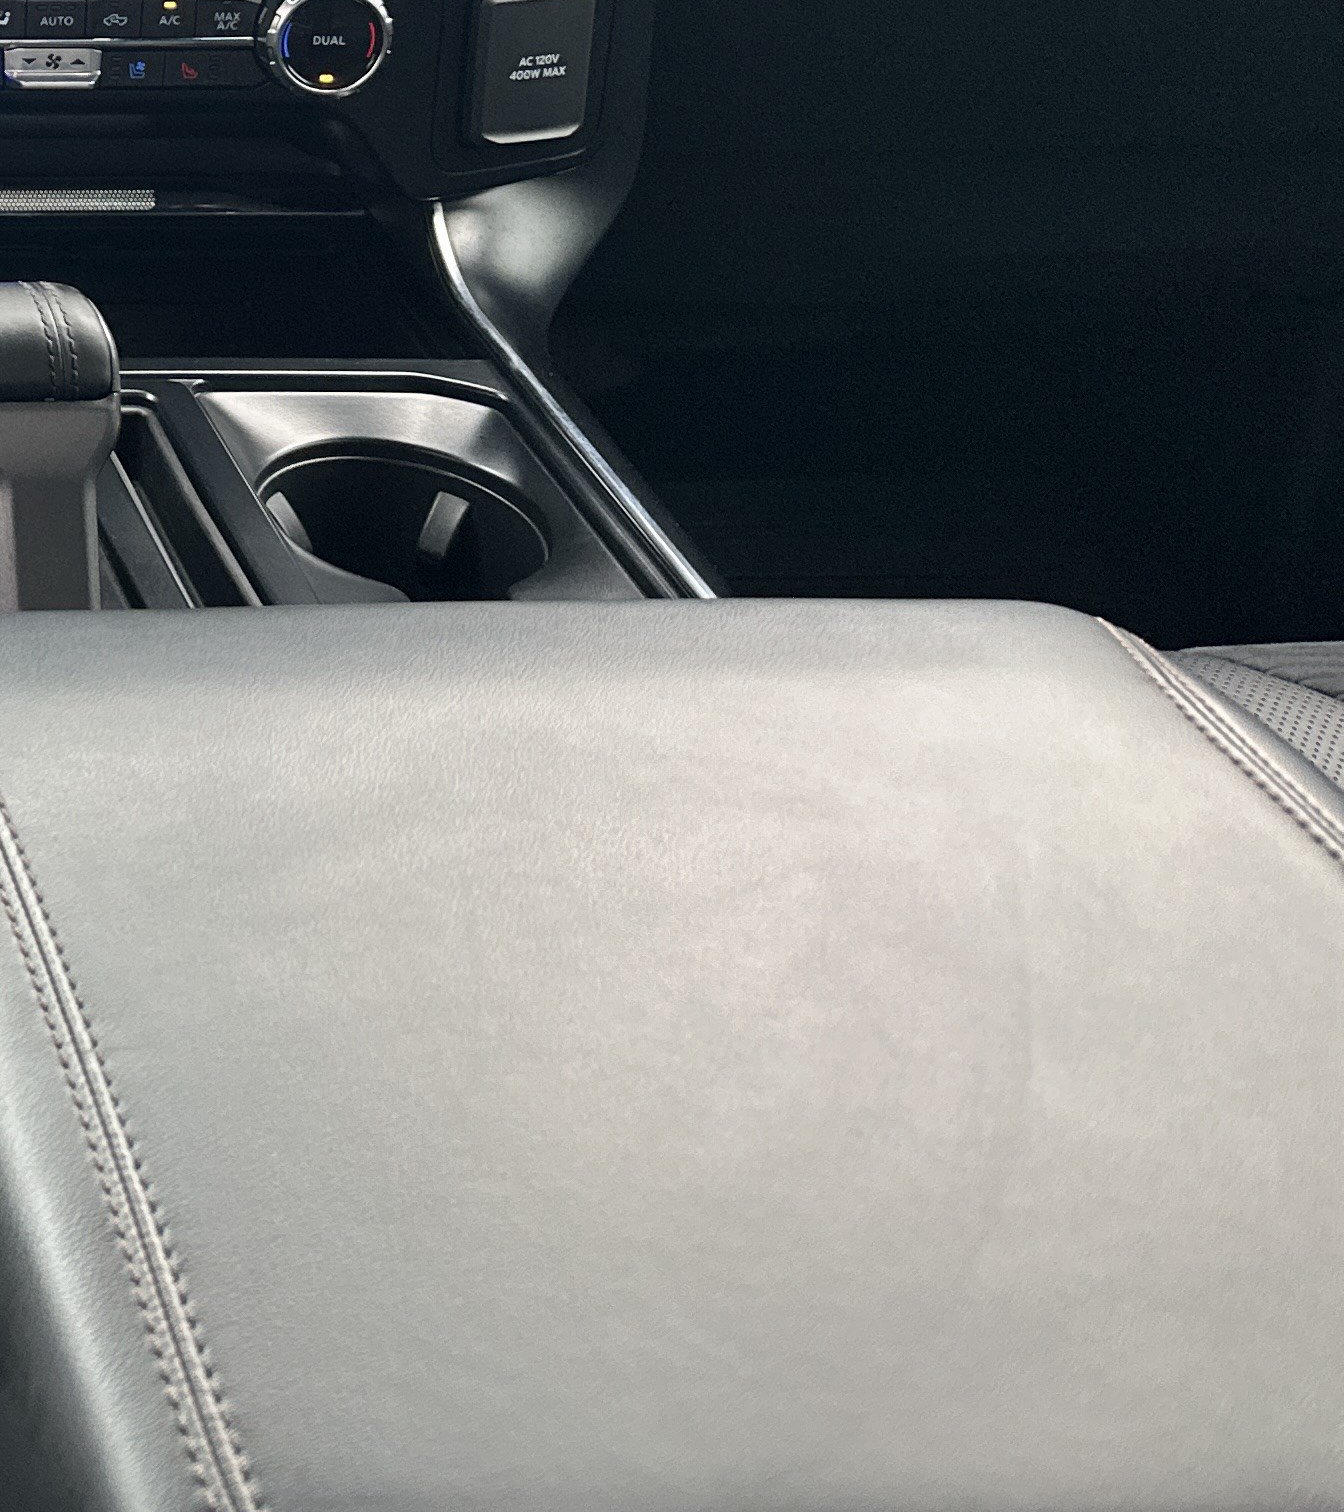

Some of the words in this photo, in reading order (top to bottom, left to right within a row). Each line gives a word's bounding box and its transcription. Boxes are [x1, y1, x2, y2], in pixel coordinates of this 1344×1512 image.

[39, 16, 74, 26] AUTO
[159, 15, 181, 26] A/C
[214, 11, 241, 22] MAX
[216, 21, 238, 31] A/C
[313, 35, 346, 46] DUAL
[519, 55, 533, 66] AC
[535, 54, 560, 66] 120V
[509, 68, 541, 81] 400W
[543, 65, 566, 77] MAX
